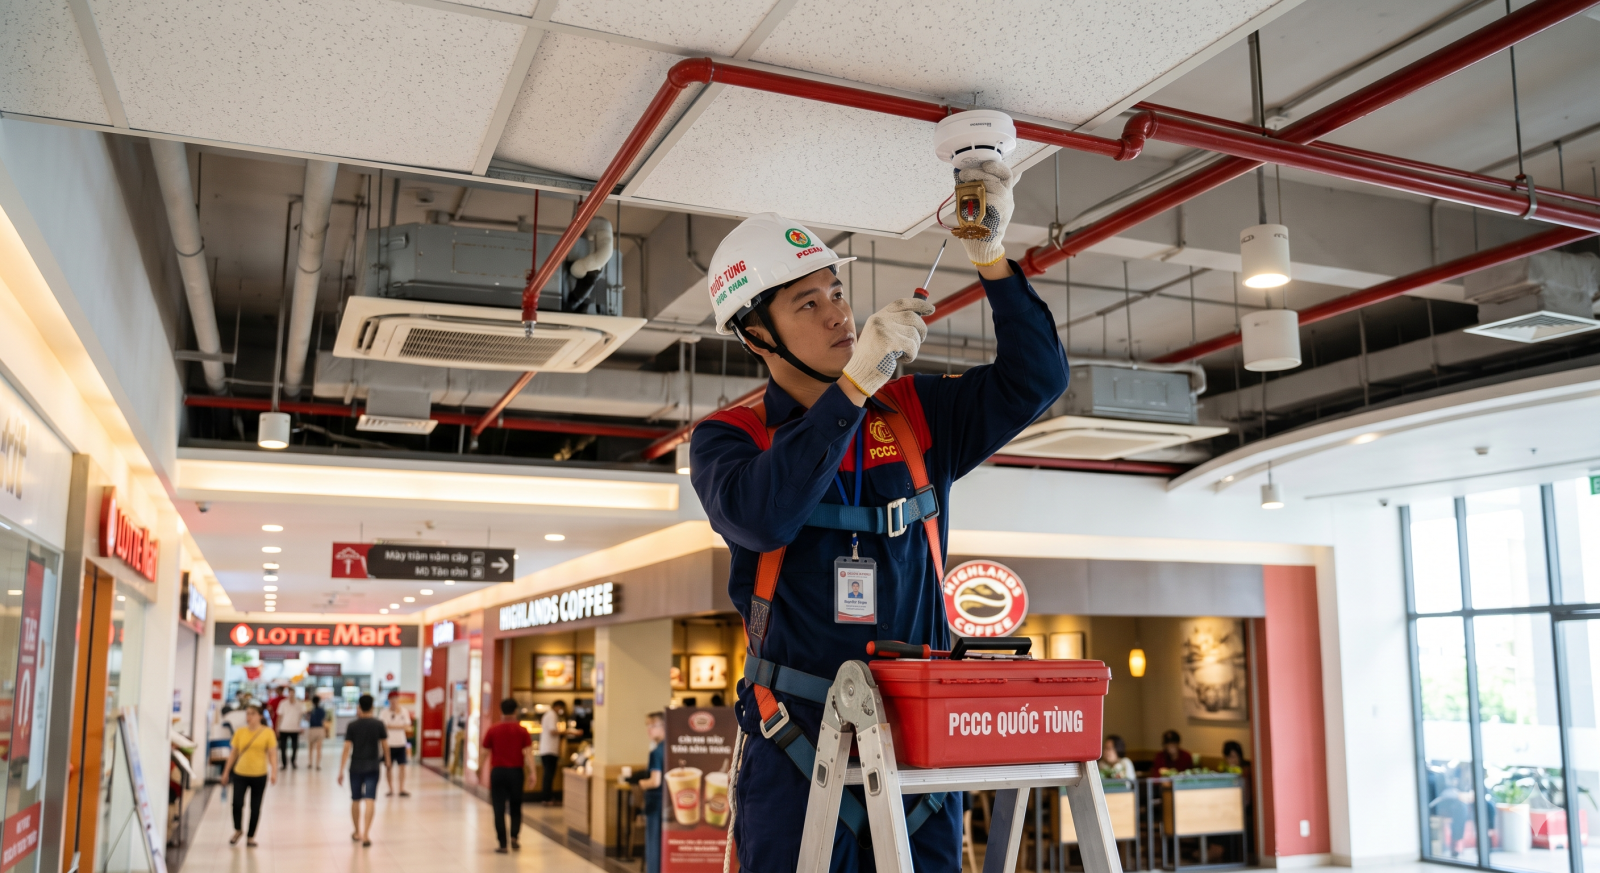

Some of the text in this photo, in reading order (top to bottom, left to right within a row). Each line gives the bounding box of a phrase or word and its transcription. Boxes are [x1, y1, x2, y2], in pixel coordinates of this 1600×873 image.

[869, 445, 897, 460] PCCC
[944, 564, 1023, 598] HIGHLANDS
[499, 582, 614, 631] HIGHLANDS COFFEE
[256, 622, 402, 646] LOTTE Mart
[953, 616, 1014, 637] COFFEE
[949, 703, 1083, 737] PCCC QUỐC TÙNG
